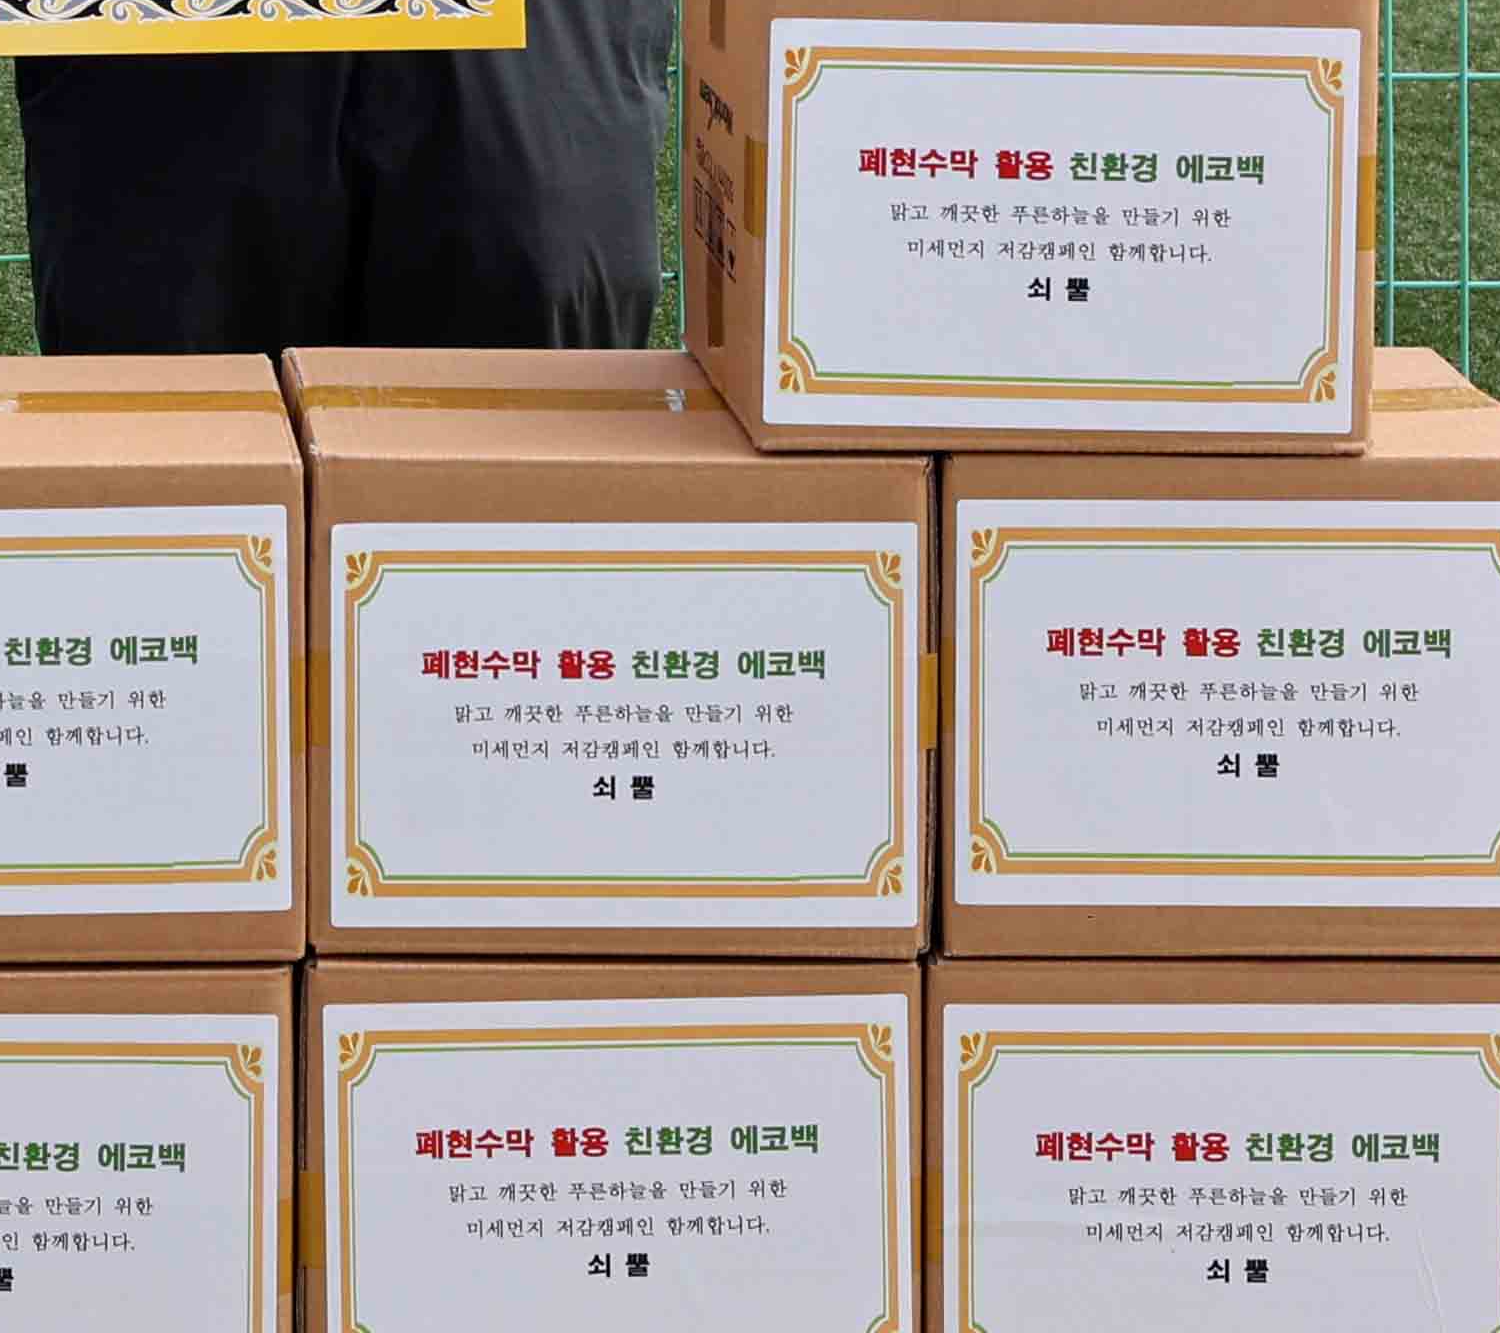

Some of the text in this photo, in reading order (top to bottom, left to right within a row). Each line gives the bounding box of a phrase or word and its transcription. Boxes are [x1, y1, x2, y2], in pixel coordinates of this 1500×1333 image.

[858, 146, 1265, 185] 폐현수막 활용 친환경 에코백
[890, 202, 1231, 228] 맑고 깨끗한 푸른하늘을 만들기 위한
[907, 238, 1212, 264] 미세먼지 저감캠페인 함께합니다.
[3, 636, 92, 667] 친환경
[109, 634, 198, 666] 에코백
[1045, 627, 1451, 659] 폐현수막 활용 친환경 에코백
[421, 649, 825, 681] 폐현수막 활용 친환경 에코백
[57, 690, 114, 710] 만들기
[127, 689, 166, 710] 위한
[45, 725, 149, 747] 함께합니다.
[97, 1142, 186, 1174] 에코백
[415, 1124, 819, 1160] 폐현수막 활용 친환경 에코백
[1035, 1131, 1440, 1163] 폐현수막 활용 친환경 에코백
[1068, 1185, 1409, 1207] 맑고 깨끗한 푸른하늘을 만들기 위한
[1085, 1222, 1390, 1244] 미세먼지 저감캠페인 함께합니다.
